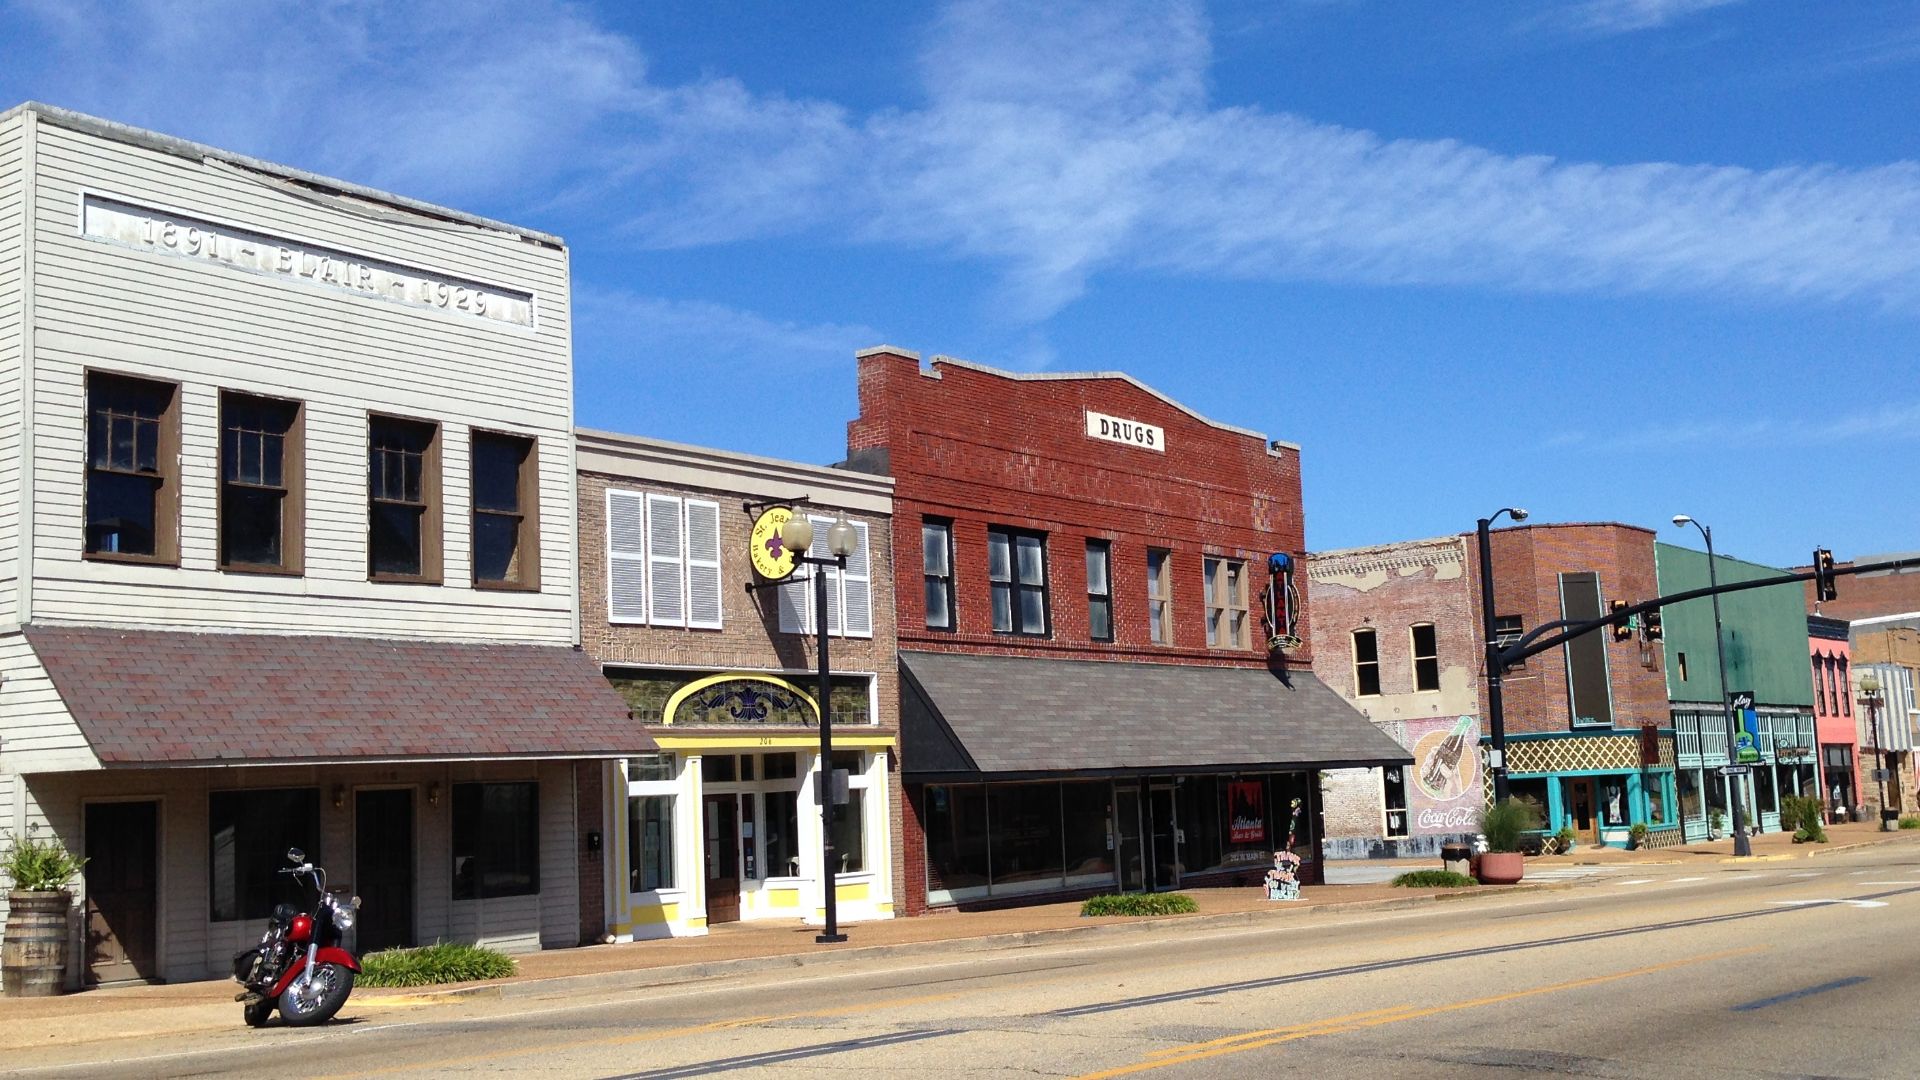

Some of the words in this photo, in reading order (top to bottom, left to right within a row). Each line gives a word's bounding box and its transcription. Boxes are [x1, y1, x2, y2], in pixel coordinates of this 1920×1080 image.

[143, 216, 219, 258] 1891
[274, 246, 375, 292] BLAIR
[421, 278, 488, 317] 1929
[1099, 418, 1154, 446] DRUGS
[1734, 694, 1751, 711] play
[1232, 815, 1262, 831] Atlanta
